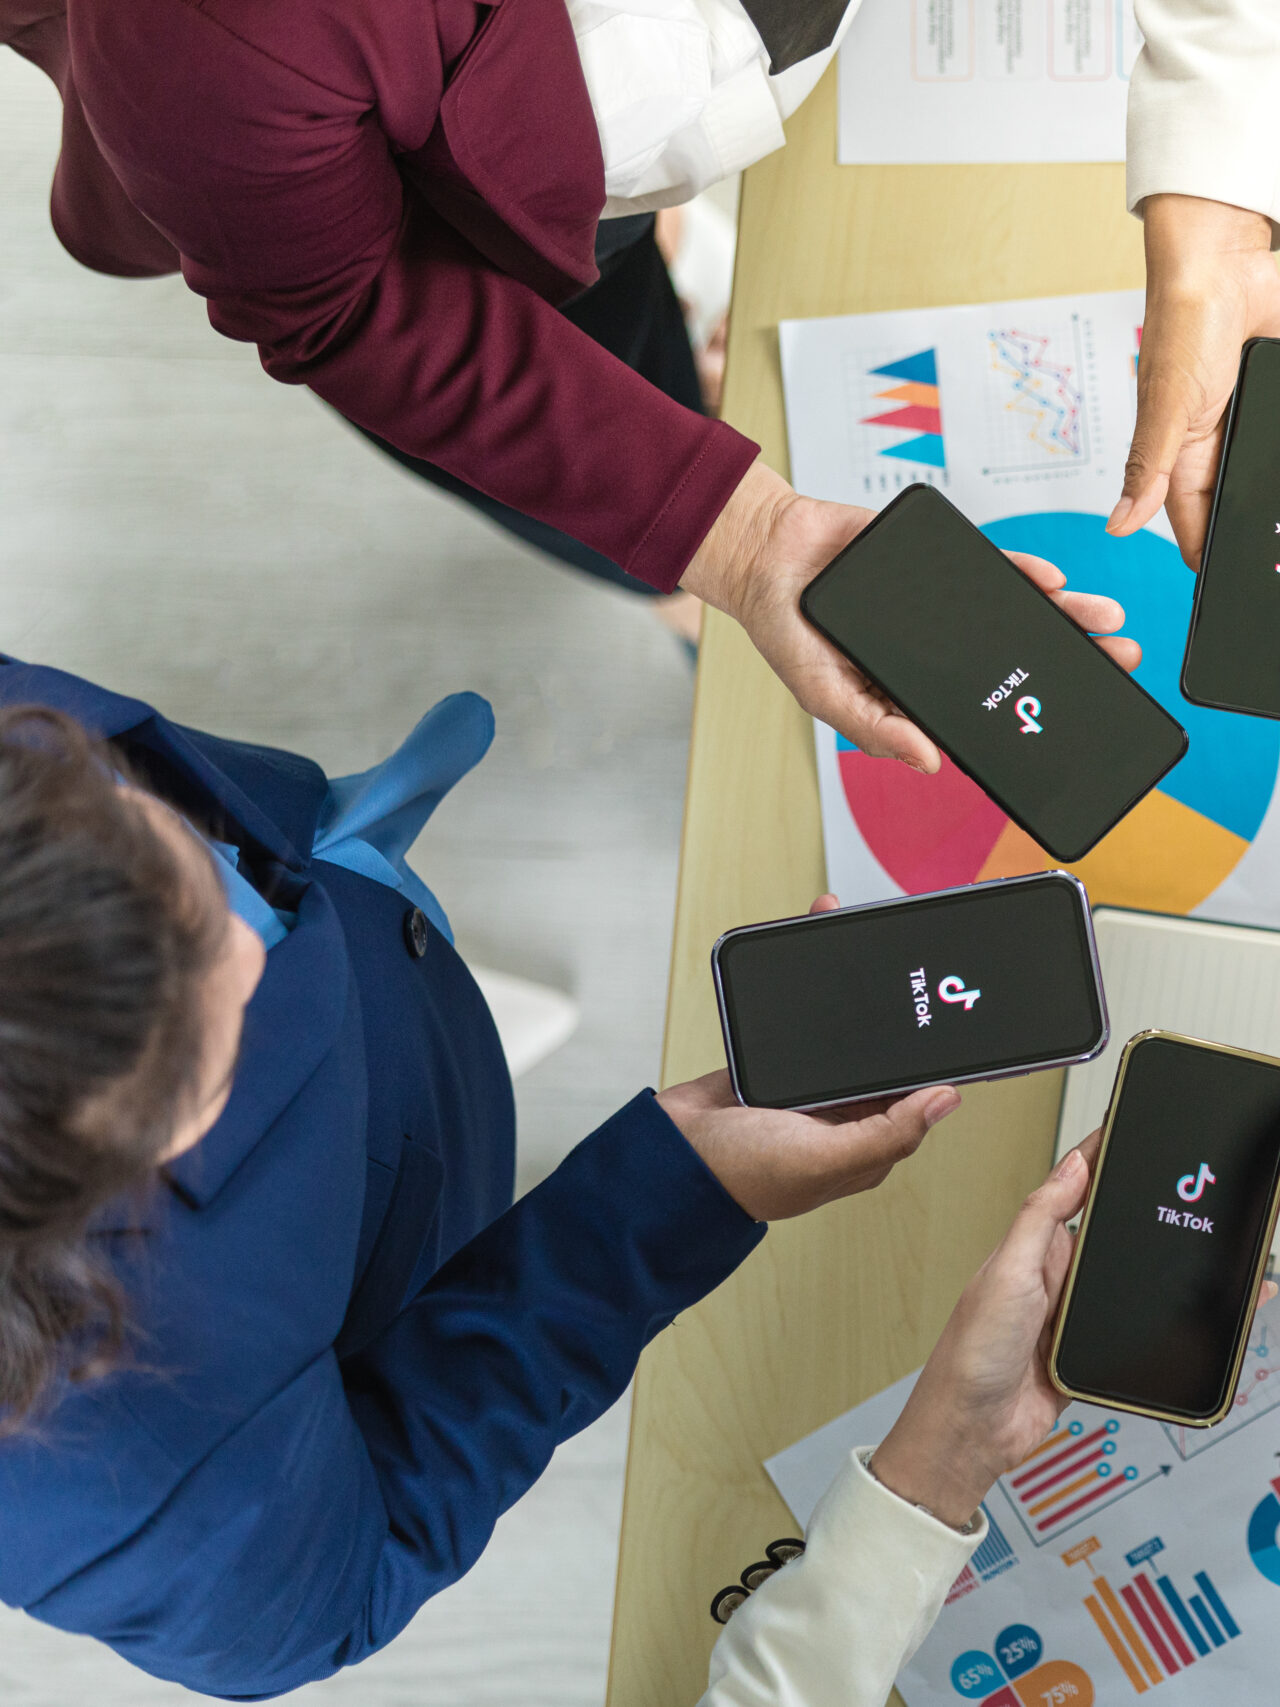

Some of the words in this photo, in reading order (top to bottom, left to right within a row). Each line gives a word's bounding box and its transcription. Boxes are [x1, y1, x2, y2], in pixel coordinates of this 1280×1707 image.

[981, 667, 1030, 712] TikTok
[909, 967, 933, 1029] TikTok
[1157, 1205, 1214, 1234] TikTok
[1000, 1636, 1038, 1665] 25%
[958, 1663, 995, 1690] 65%
[1040, 1680, 1079, 1707] 75%
